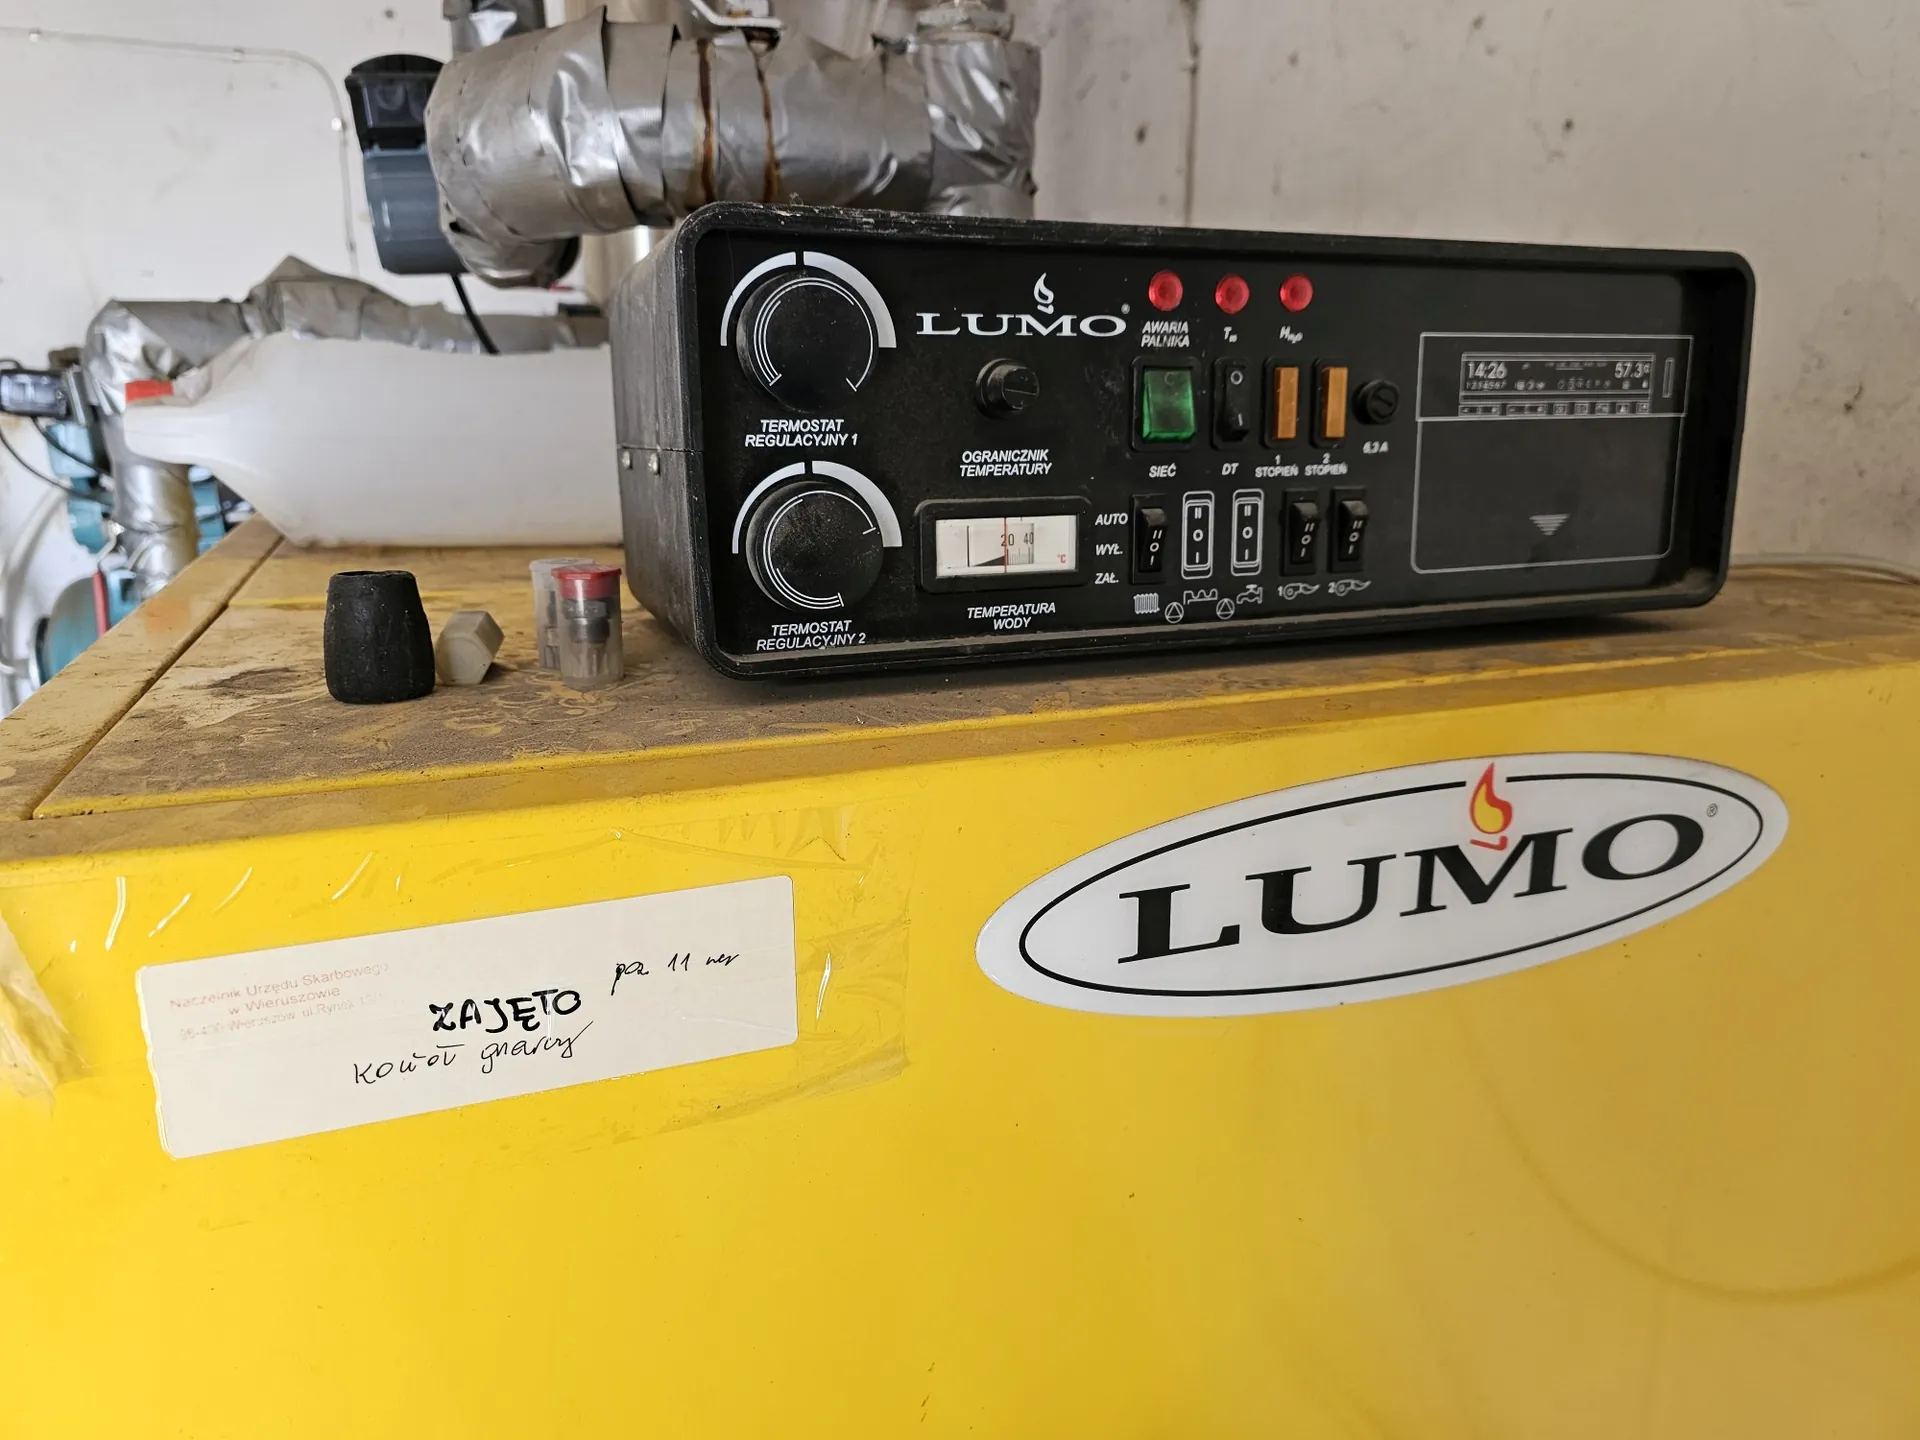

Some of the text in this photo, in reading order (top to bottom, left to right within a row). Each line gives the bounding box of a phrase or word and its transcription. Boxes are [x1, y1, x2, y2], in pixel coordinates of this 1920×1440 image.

[916, 312, 1127, 337] LUMO
[1142, 321, 1189, 334] AWARIA
[1141, 334, 1190, 348] PALNIKA
[760, 419, 844, 433] TERMOSTAT
[745, 433, 858, 447] REGULACYJNY 1
[962, 449, 1049, 463] OGRANICZNIK
[1275, 455, 1281, 464] 1
[1323, 453, 1331, 463] 2
[960, 463, 1052, 477] TEMPERATURY
[1149, 462, 1177, 478] SIEĆ
[1221, 463, 1239, 475] DT
[1255, 465, 1299, 478] STOPIEŃ
[1304, 462, 1348, 476] STOPIEŃ
[1095, 513, 1128, 526] AUTO
[1000, 531, 1034, 547] 20 40
[1095, 543, 1123, 556] WYŁ.
[1095, 572, 1119, 585] ZAŁ.
[967, 602, 1056, 619] TEMPERATURA
[771, 620, 852, 636] TERMOSTAT
[993, 617, 1031, 630] WODY
[756, 633, 866, 651] REGULACYJNY 2
[1117, 812, 1705, 965] LUMO
[668, 953, 690, 971] 11
[246, 979, 299, 997] Urzędu
[228, 988, 341, 1016] w Wieruszowie
[428, 988, 582, 1033] ZAJĘTO
